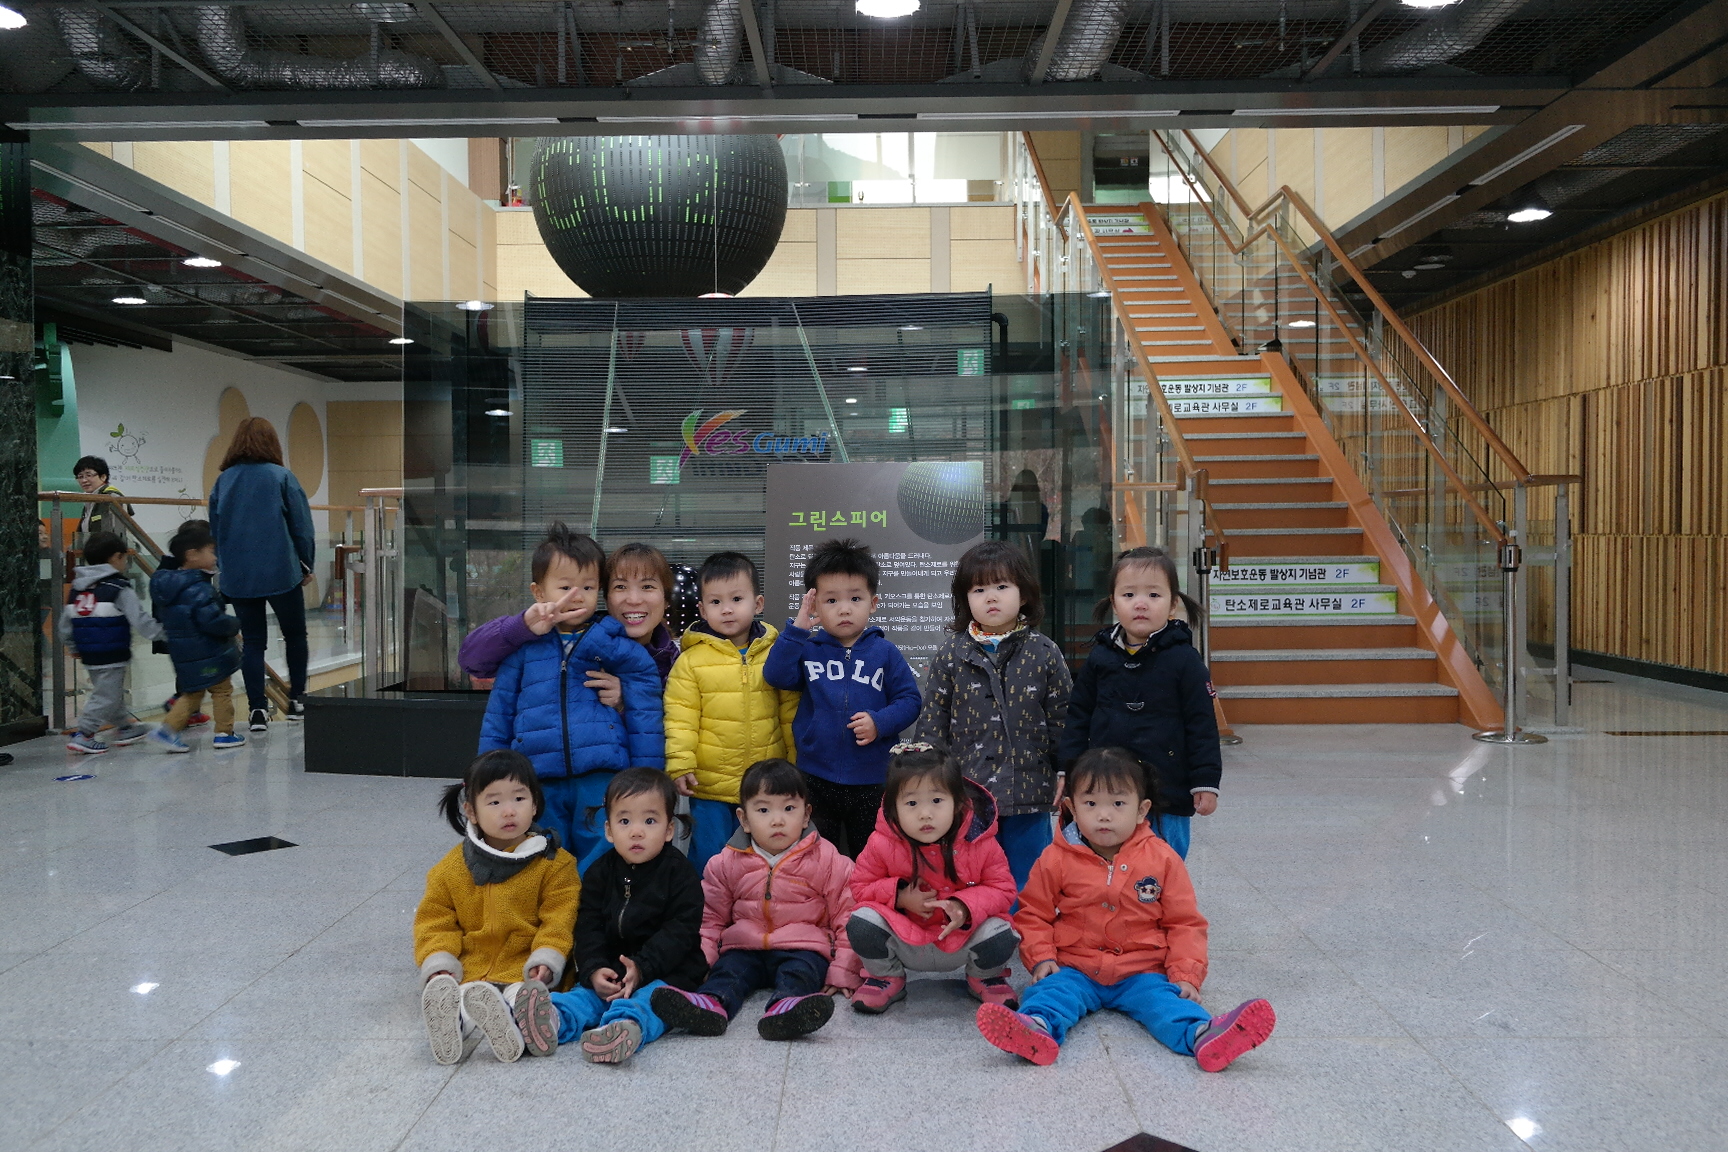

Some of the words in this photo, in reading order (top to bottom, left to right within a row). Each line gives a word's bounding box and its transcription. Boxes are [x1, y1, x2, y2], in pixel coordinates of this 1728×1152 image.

[1184, 383, 1206, 394] 발상지
[1207, 382, 1230, 393] 기념관
[1236, 383, 1248, 392] 2F
[1213, 401, 1239, 412] 사무실
[1246, 402, 1257, 411] 2F
[753, 431, 828, 454] Gumi
[788, 510, 887, 531] 그린스피어
[1213, 568, 1267, 582] 자연보호운동
[1270, 568, 1297, 581] 발상지
[1299, 568, 1327, 581] 기념관
[1335, 568, 1350, 579] 2F
[1225, 597, 1305, 612] 탄소제로교육관
[1309, 597, 1342, 611] 사무실
[1351, 598, 1366, 609] 2F
[804, 659, 884, 692] POLO
